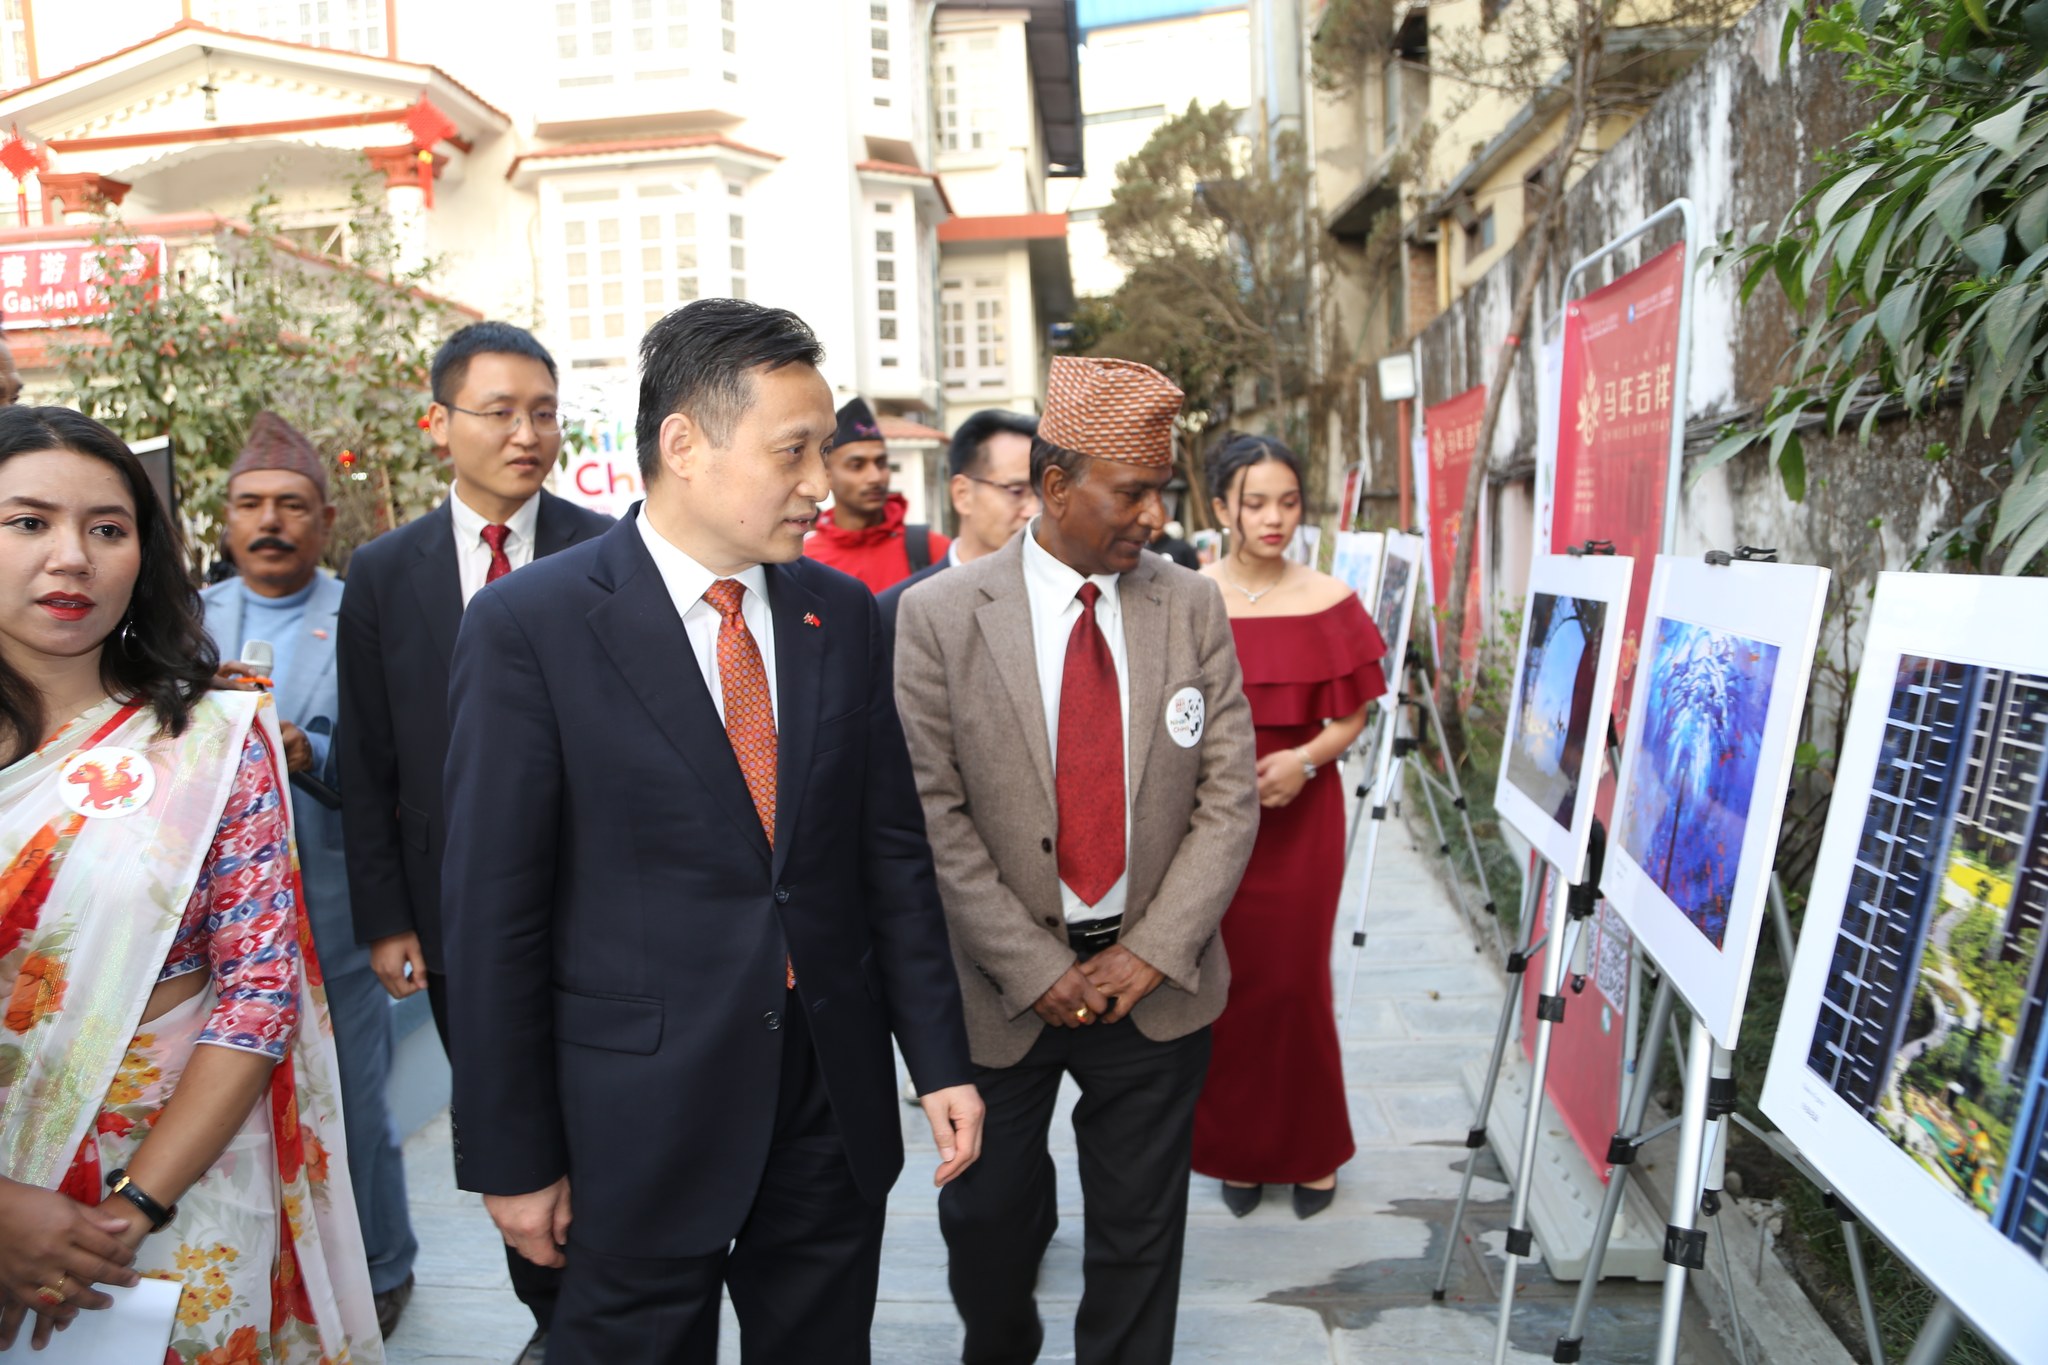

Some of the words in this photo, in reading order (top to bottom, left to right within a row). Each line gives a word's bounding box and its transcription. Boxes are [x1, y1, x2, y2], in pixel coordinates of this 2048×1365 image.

[2, 286, 79, 313] Garden
[1604, 362, 1671, 422] 马年吉祥
[576, 462, 645, 496] Ch
